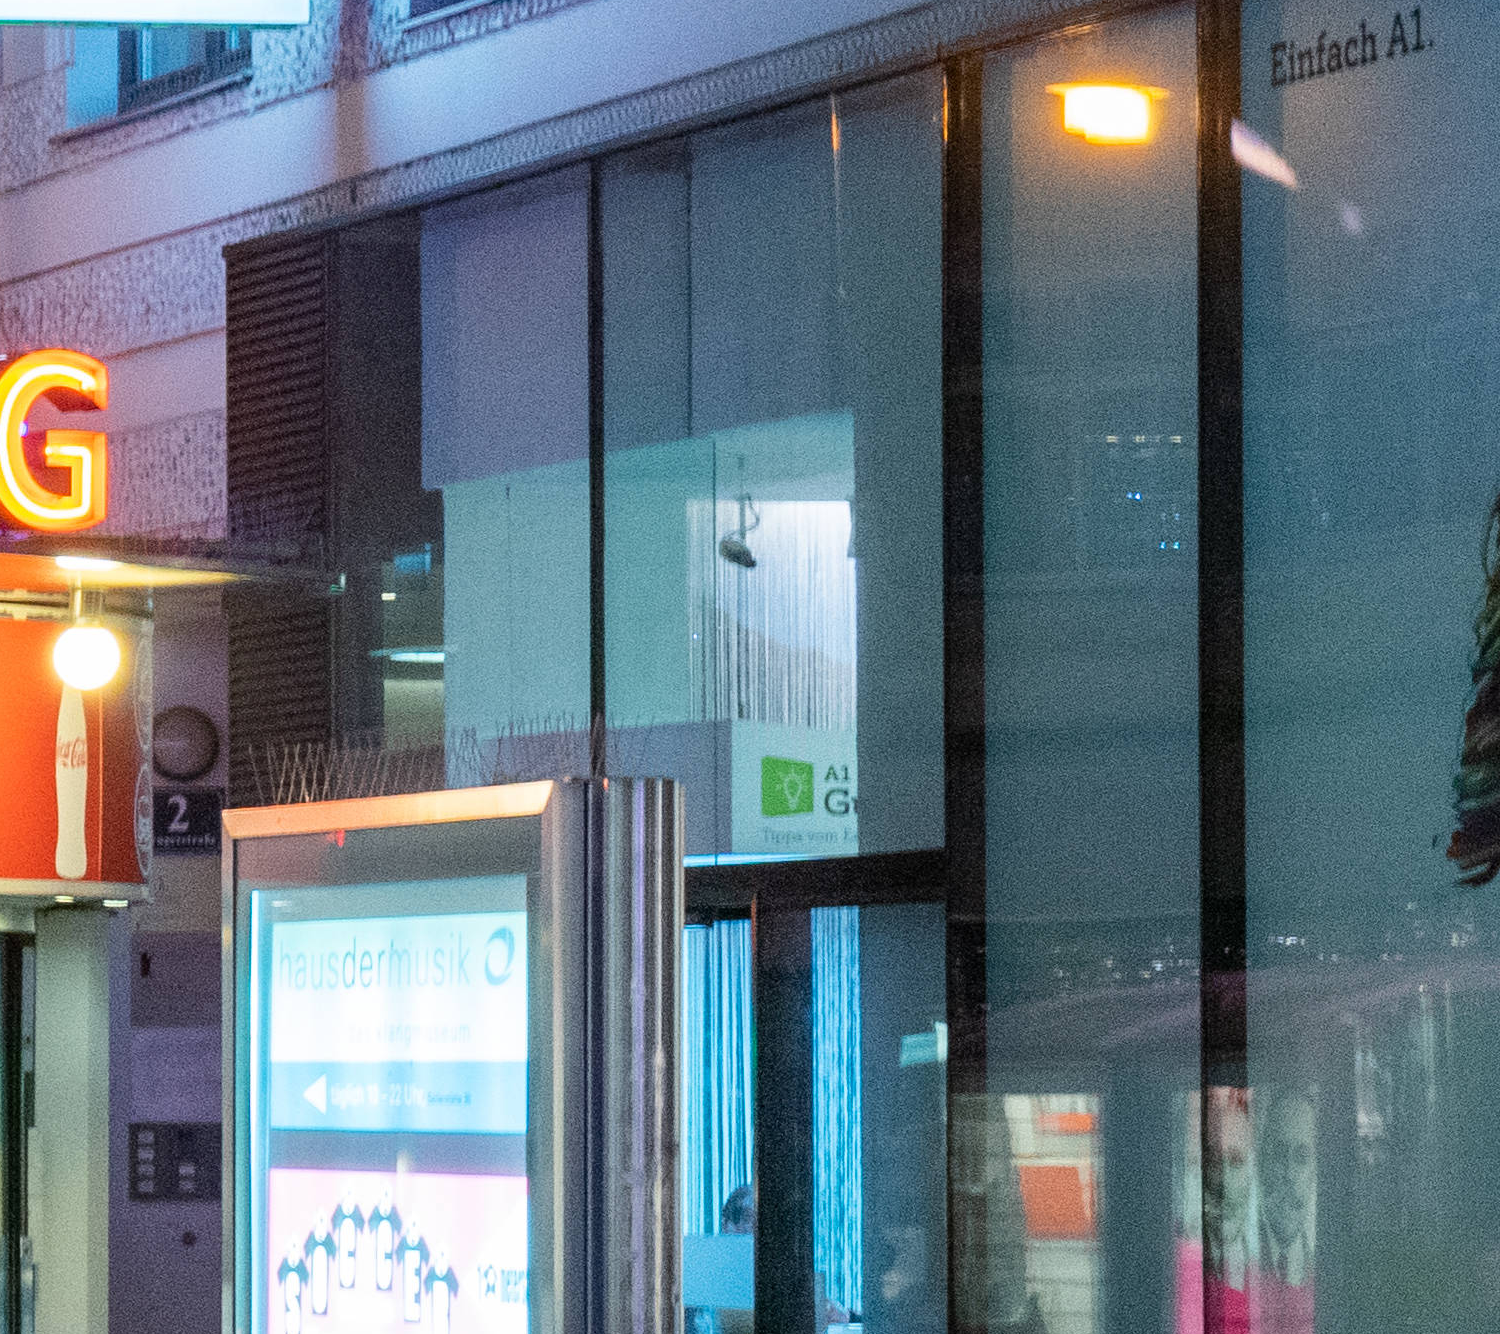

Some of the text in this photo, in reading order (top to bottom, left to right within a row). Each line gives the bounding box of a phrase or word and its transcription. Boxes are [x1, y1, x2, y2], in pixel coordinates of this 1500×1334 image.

[1270, 5, 1434, 88] Einfach A1.
[824, 764, 850, 782] A1
[167, 794, 190, 833] 2
